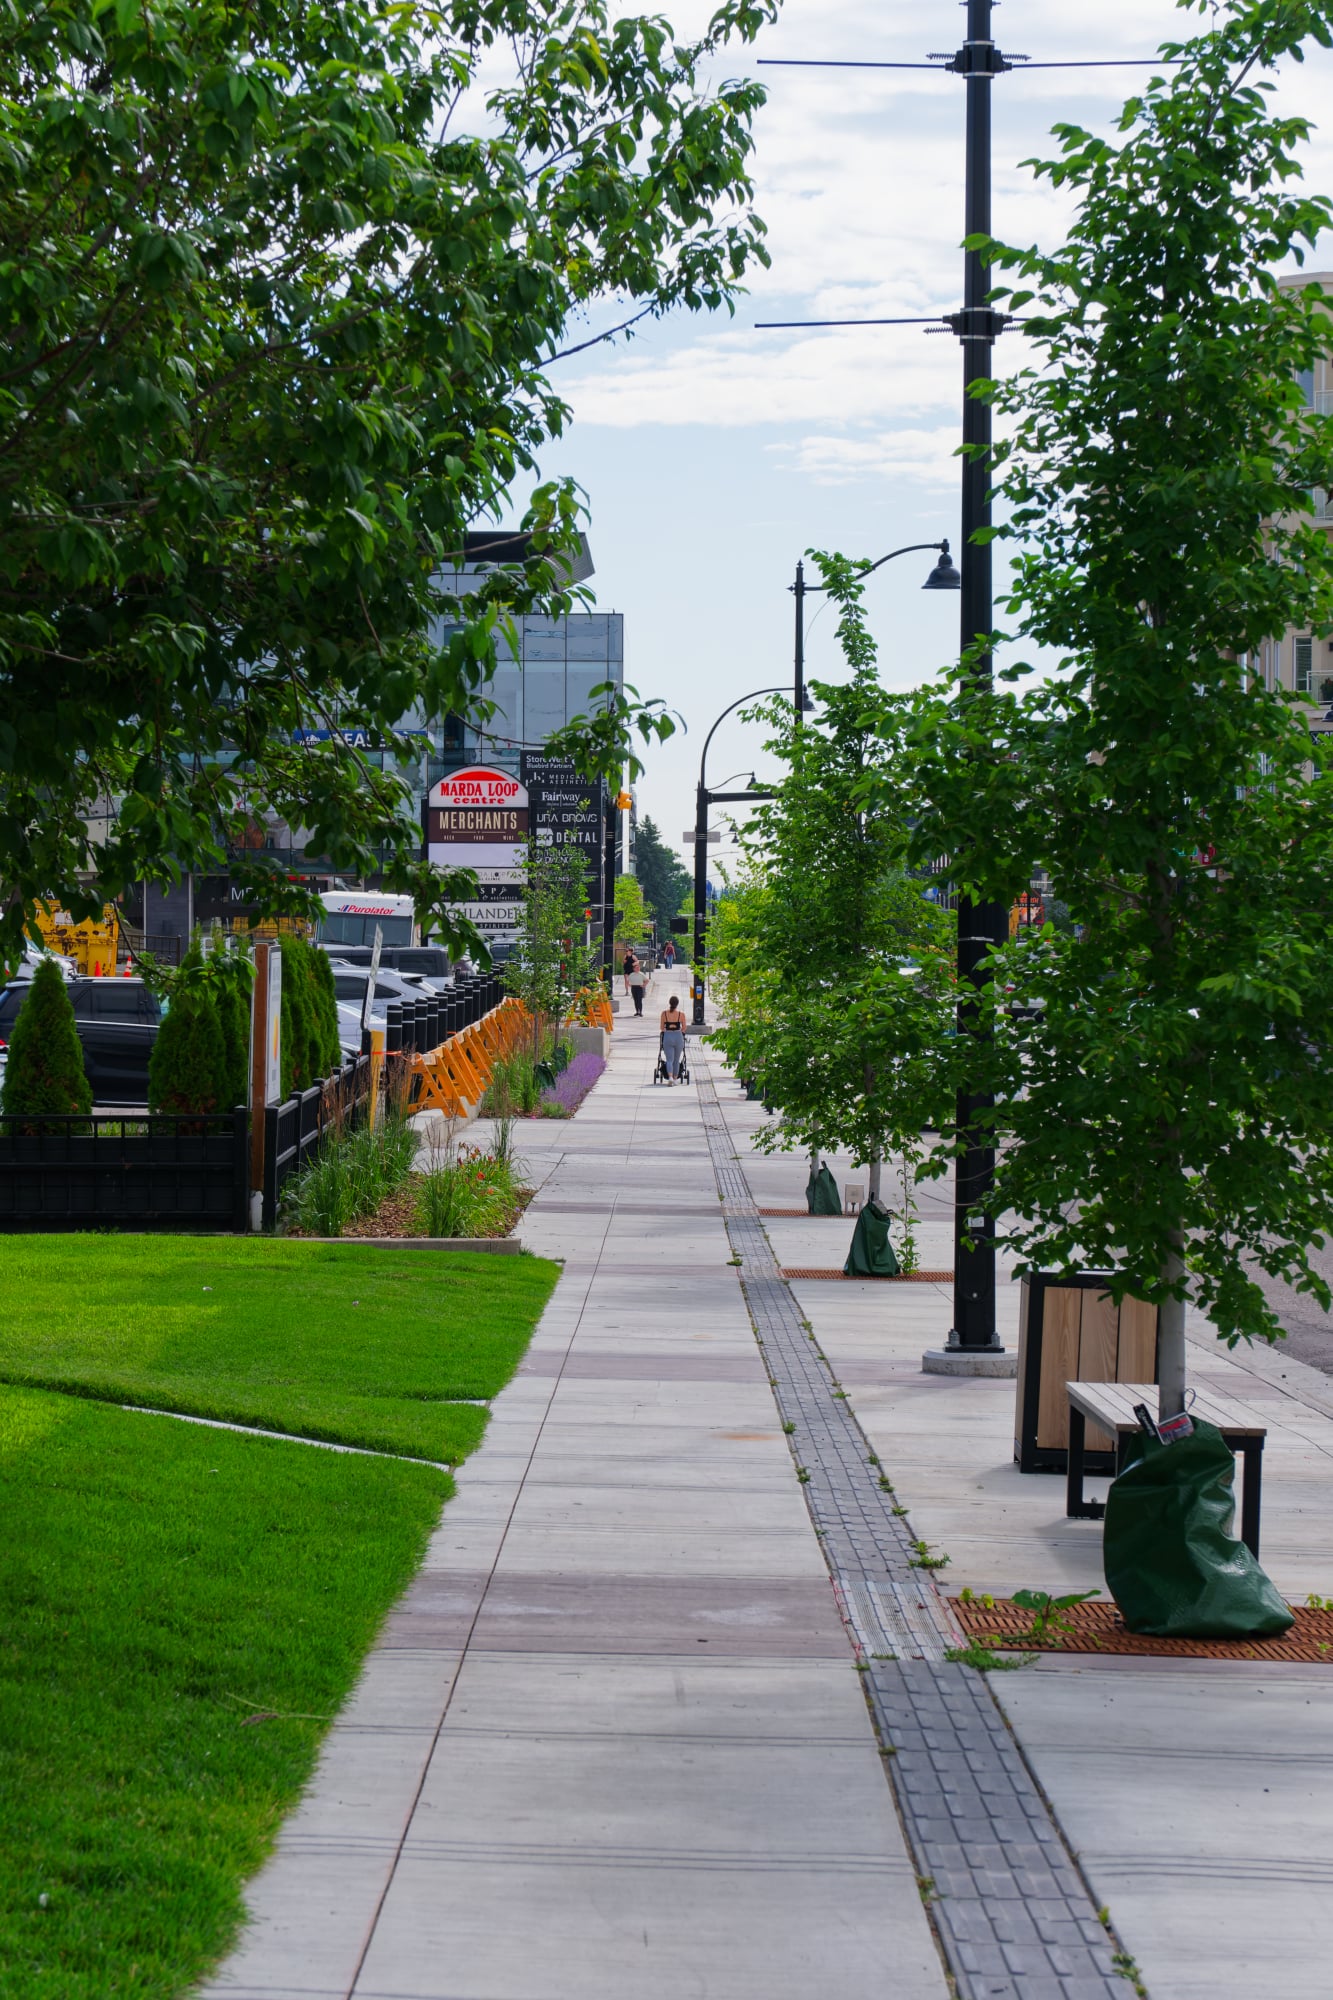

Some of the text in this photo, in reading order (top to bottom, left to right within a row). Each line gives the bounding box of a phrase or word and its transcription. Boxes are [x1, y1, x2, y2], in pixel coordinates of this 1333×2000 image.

[440, 782, 519, 796] MARDA LOOP
[542, 791, 581, 803] Fairway
[439, 811, 517, 830] MERCHANTS
[561, 813, 598, 823] BROWS
[556, 832, 598, 843] DENTAL
[347, 904, 396, 915] Purolator
